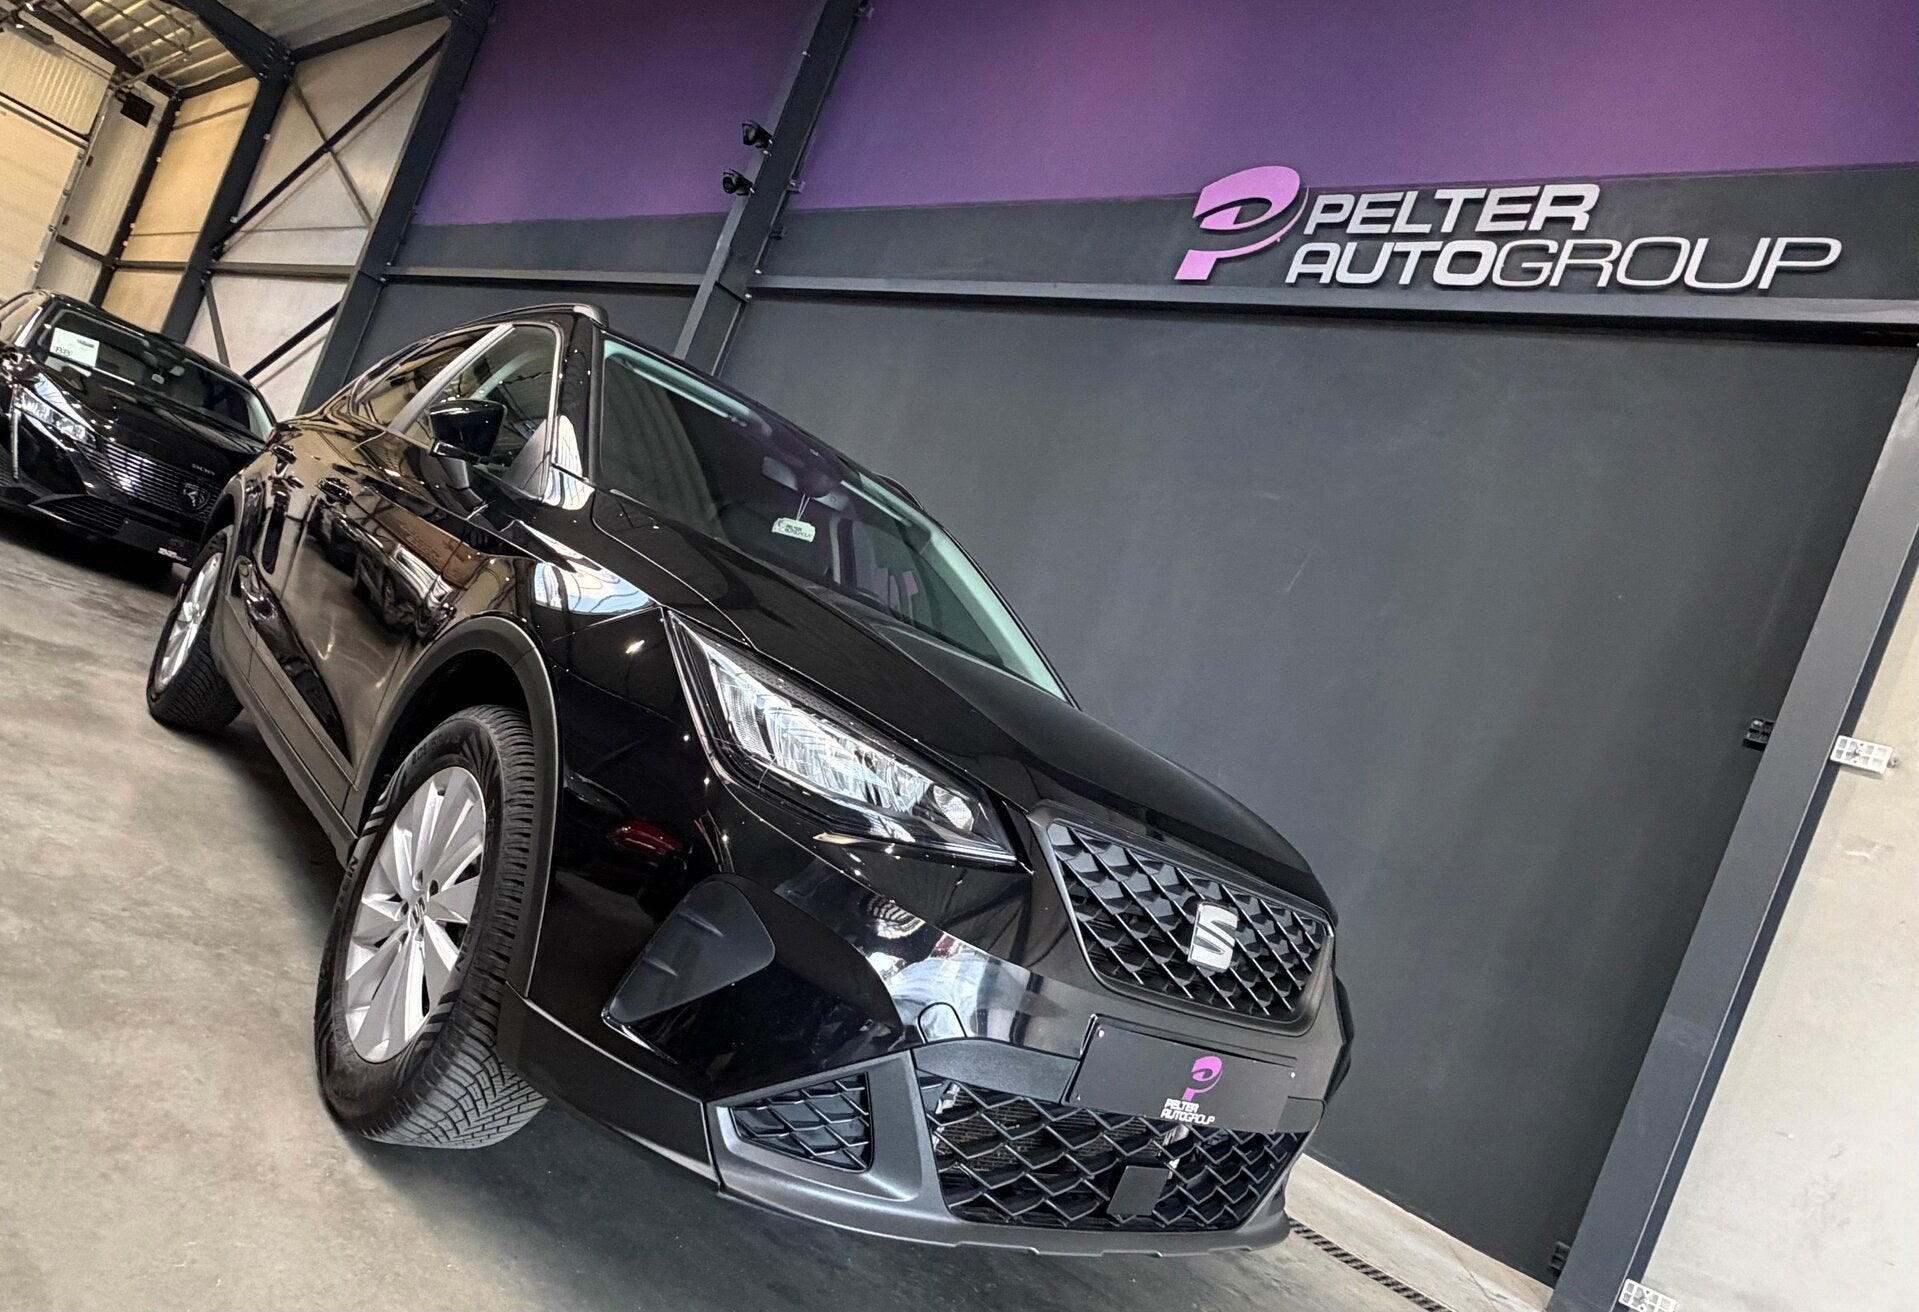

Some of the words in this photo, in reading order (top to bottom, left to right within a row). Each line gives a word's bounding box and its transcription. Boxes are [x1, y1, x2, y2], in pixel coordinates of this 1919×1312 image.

[1303, 184, 1600, 235] PELTER
[1285, 237, 1842, 290] AUTOGROUP
[1160, 1108, 1216, 1125] AUTOGROUP
[1164, 1098, 1199, 1113] PELTER
